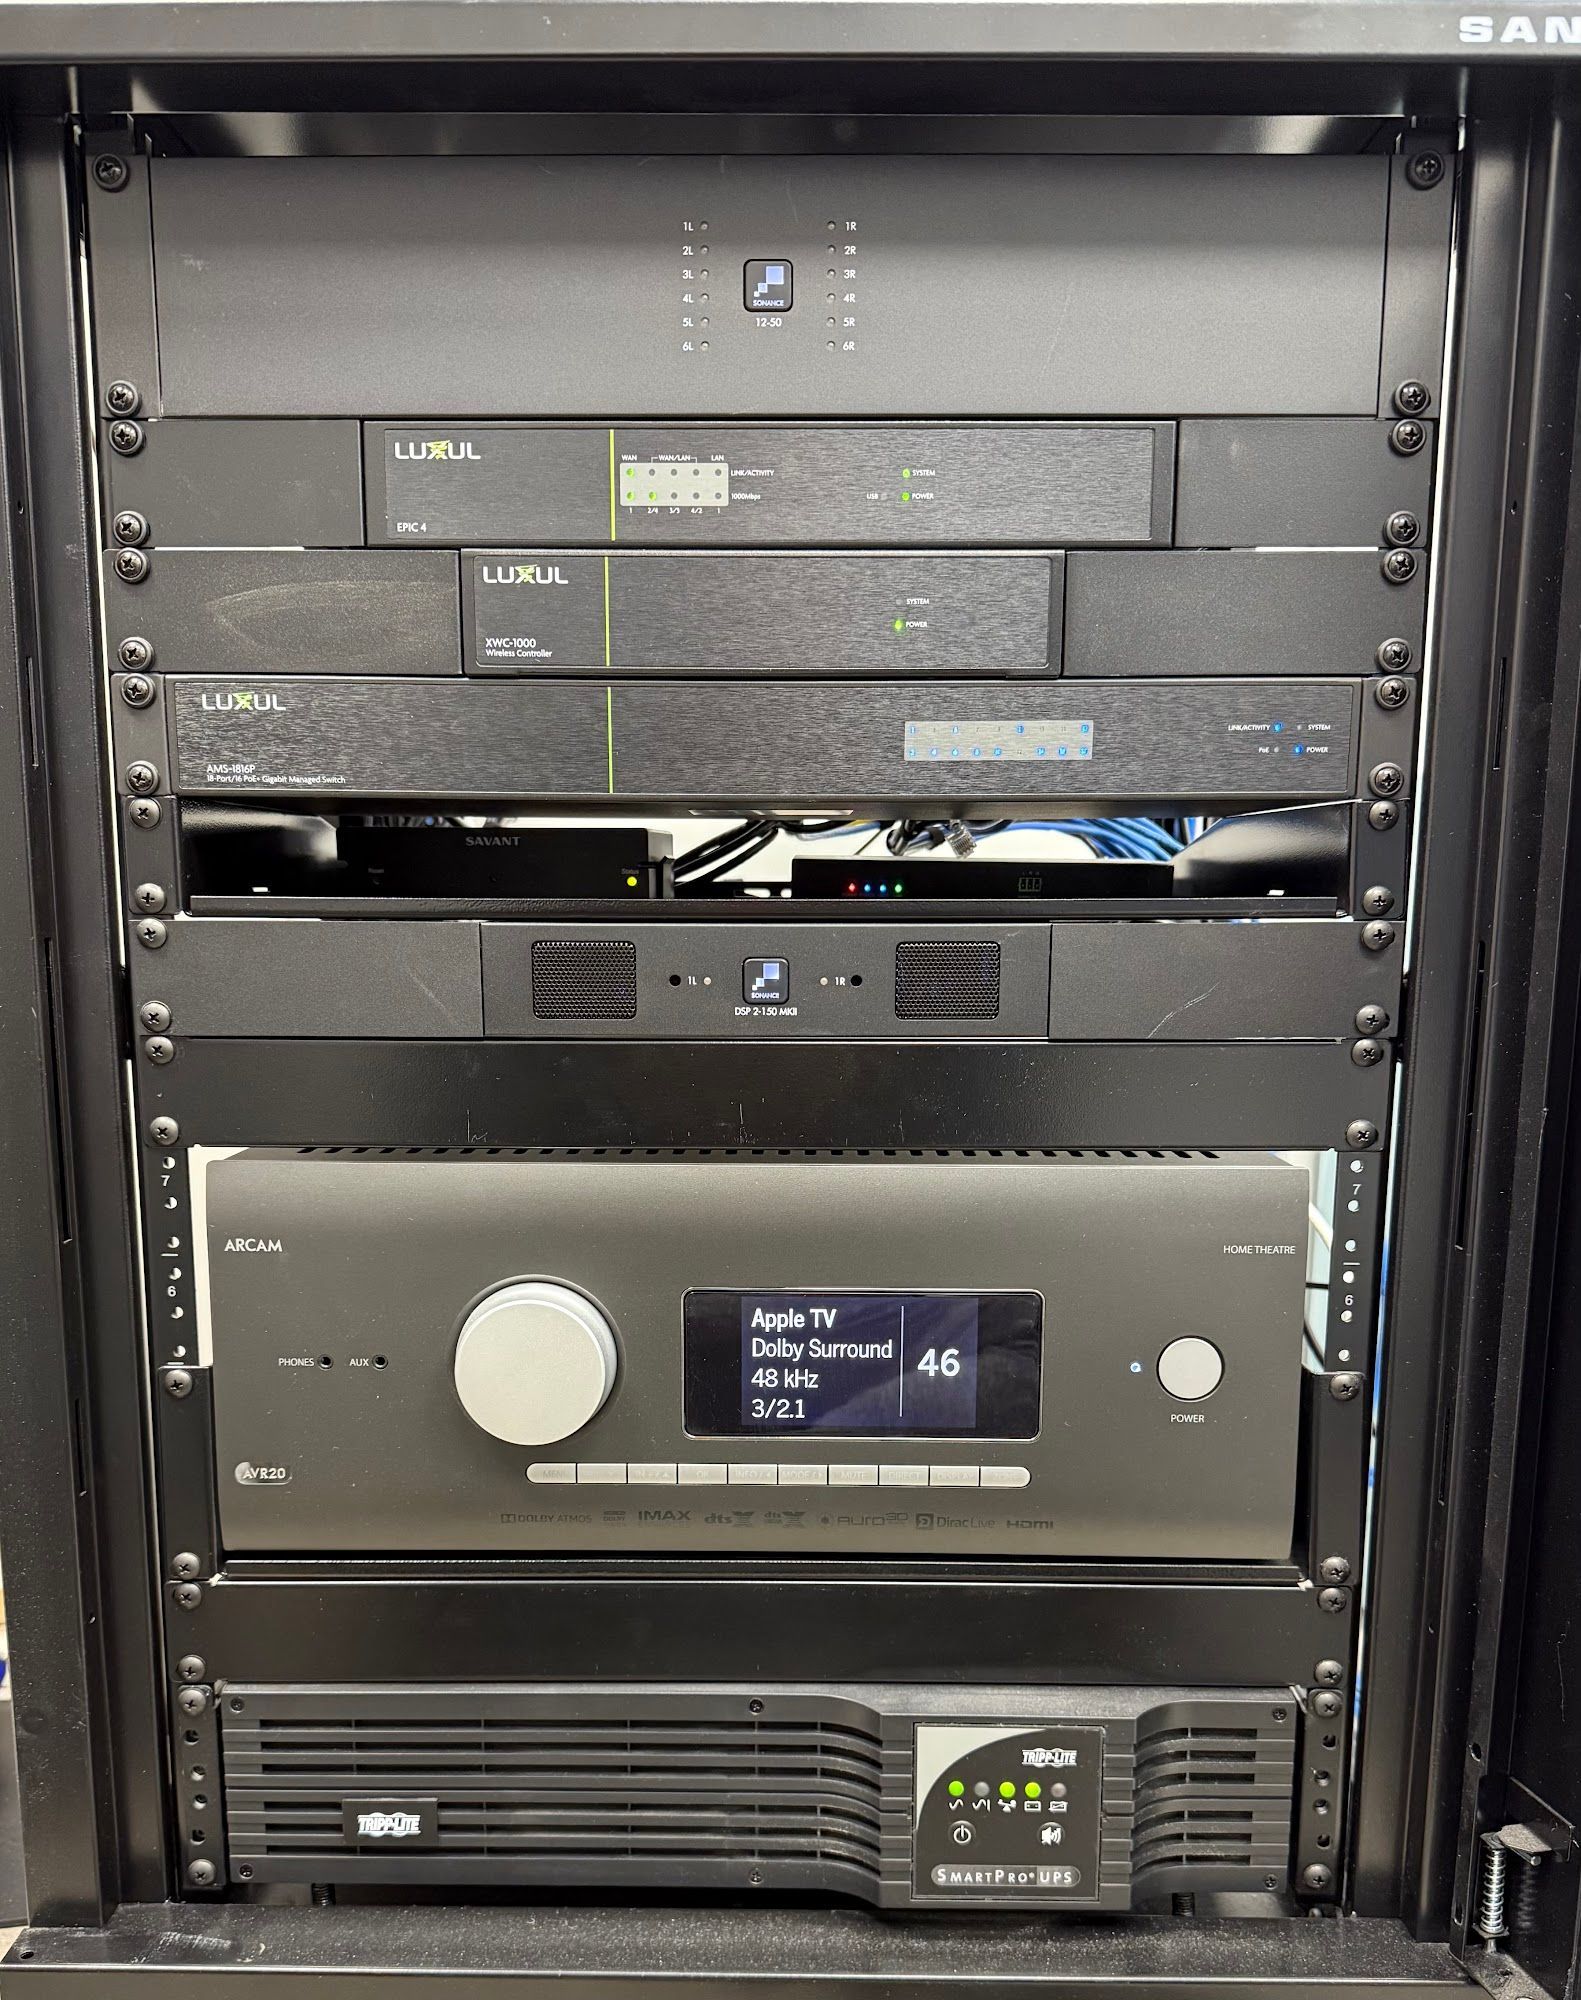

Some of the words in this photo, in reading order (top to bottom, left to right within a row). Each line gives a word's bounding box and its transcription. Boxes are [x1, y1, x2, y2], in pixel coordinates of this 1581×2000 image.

[682, 222, 694, 231] 1L
[846, 222, 856, 231] 1R
[682, 246, 694, 256] 2L
[844, 246, 856, 256] 2R
[682, 270, 694, 280] 3L
[843, 270, 856, 280] 3R
[682, 294, 694, 303] 4L
[753, 299, 784, 307] SONANCE
[843, 294, 856, 303] 4R
[682, 318, 694, 327] 5L
[755, 317, 782, 327] 12-50
[843, 318, 855, 327] 5R
[682, 342, 694, 351] 6L
[842, 342, 855, 351] 6R
[394, 439, 481, 460] LUXUL
[730, 469, 775, 477] LINK/ACTIVITY
[912, 469, 936, 477] SYSTEM
[731, 492, 761, 501] 1000Mbps
[911, 492, 934, 500] POWER
[396, 522, 418, 533] EPIC
[419, 522, 427, 533] 4
[482, 564, 569, 585] LUXUL
[485, 637, 537, 649] XWC-1000
[485, 649, 516, 658] Wireless
[516, 649, 553, 658] Controller
[201, 691, 287, 711] LUXUL
[206, 764, 256, 774] AMS-1816P
[206, 775, 243, 783] 18-Port/16
[262, 775, 288, 784] Gigabit
[288, 775, 322, 785] Managed
[322, 776, 346, 784] Switch
[465, 836, 521, 847] SAVANT
[687, 976, 697, 985] 1L
[835, 976, 846, 986] 1R
[734, 1006, 751, 1016] DSP
[753, 1007, 778, 1016] 2-150
[779, 1007, 798, 1016] MKII
[161, 1175, 171, 1187] 7
[1352, 1183, 1362, 1195] 7
[224, 1238, 283, 1252] ARCAM
[1223, 1245, 1254, 1254] HOME
[1255, 1245, 1296, 1255] THEATRE
[167, 1285, 177, 1297] 6
[1344, 1294, 1354, 1306] 6
[751, 1307, 806, 1331] Apple
[811, 1308, 837, 1329] TV
[751, 1338, 804, 1362] Dolby
[808, 1338, 893, 1360] Surround
[278, 1357, 315, 1367] PHONES
[349, 1357, 369, 1367] AUX
[917, 1349, 961, 1377] 46
[751, 1368, 779, 1389] 48
[784, 1368, 820, 1389] kHz
[751, 1399, 806, 1419] 3/2.1
[1170, 1414, 1205, 1423] POWER
[242, 1467, 286, 1480] AVR20
[557, 1514, 592, 1523] ATMOS
[638, 1510, 691, 1521] IMAX
[936, 1516, 968, 1528] Dirac
[970, 1516, 995, 1528] Live
[1040, 1871, 1072, 1883] UPS
